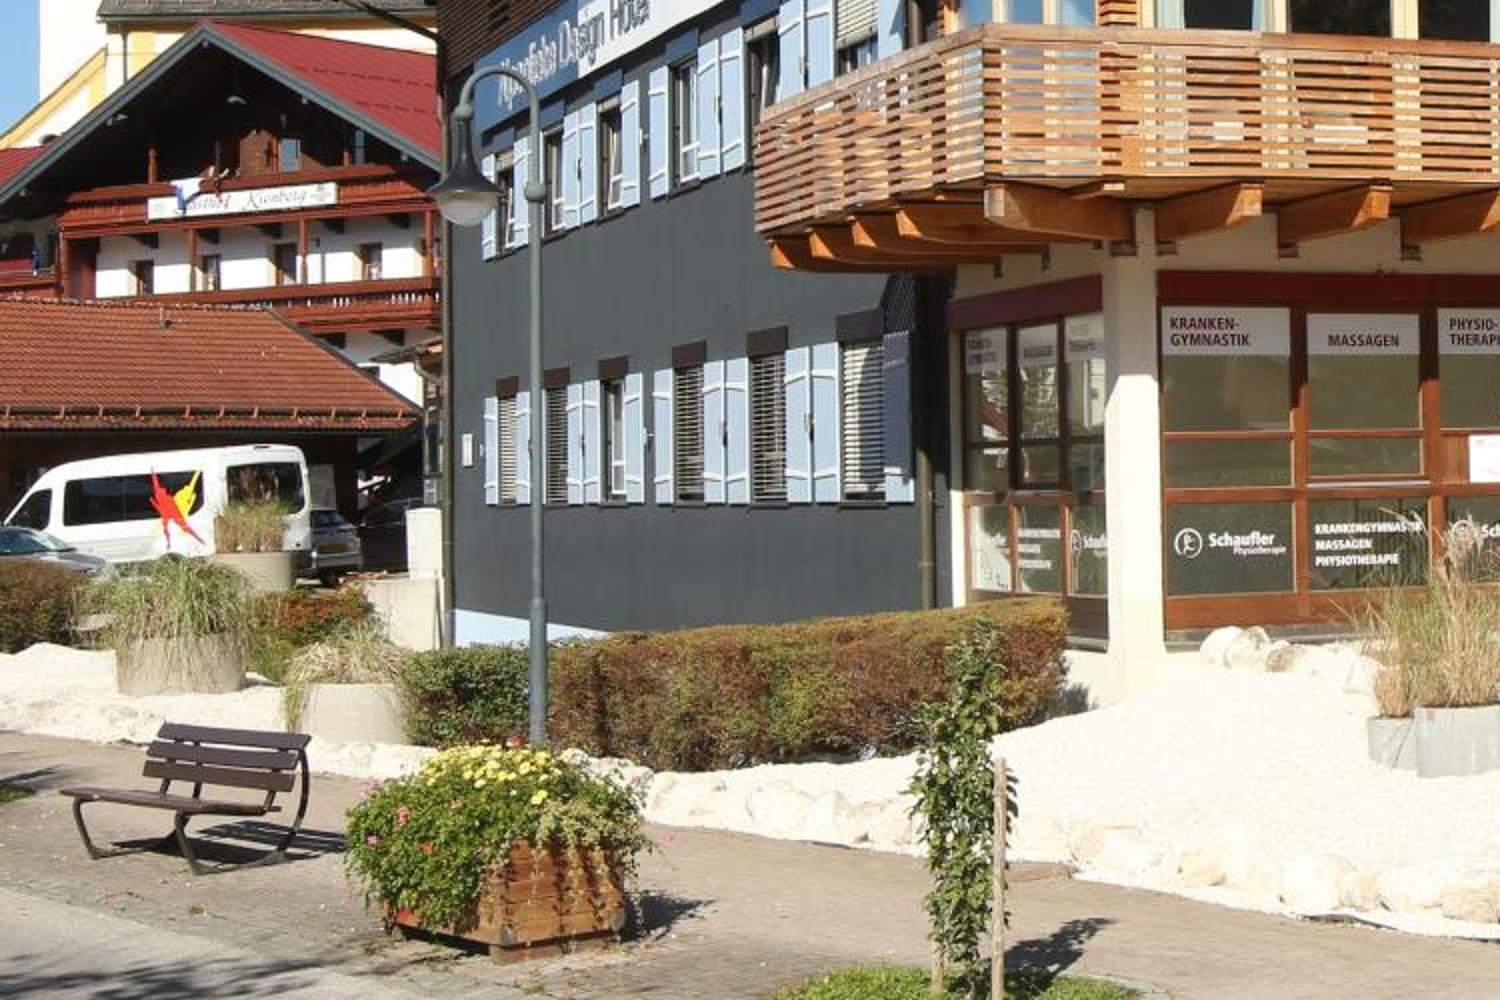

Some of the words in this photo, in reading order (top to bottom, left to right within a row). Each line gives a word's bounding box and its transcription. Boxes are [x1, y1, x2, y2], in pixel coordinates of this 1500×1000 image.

[1169, 316, 1240, 331] KRANKEN-
[1449, 316, 1499, 331] PHYSIO-
[1170, 333, 1250, 347] GYMNASTIK
[1327, 333, 1400, 348] MASSAGEN
[1207, 530, 1275, 548] Schaufler
[1314, 538, 1374, 551] MASSAGEN
[1314, 552, 1400, 568] PHYSIOTHERAPIE
